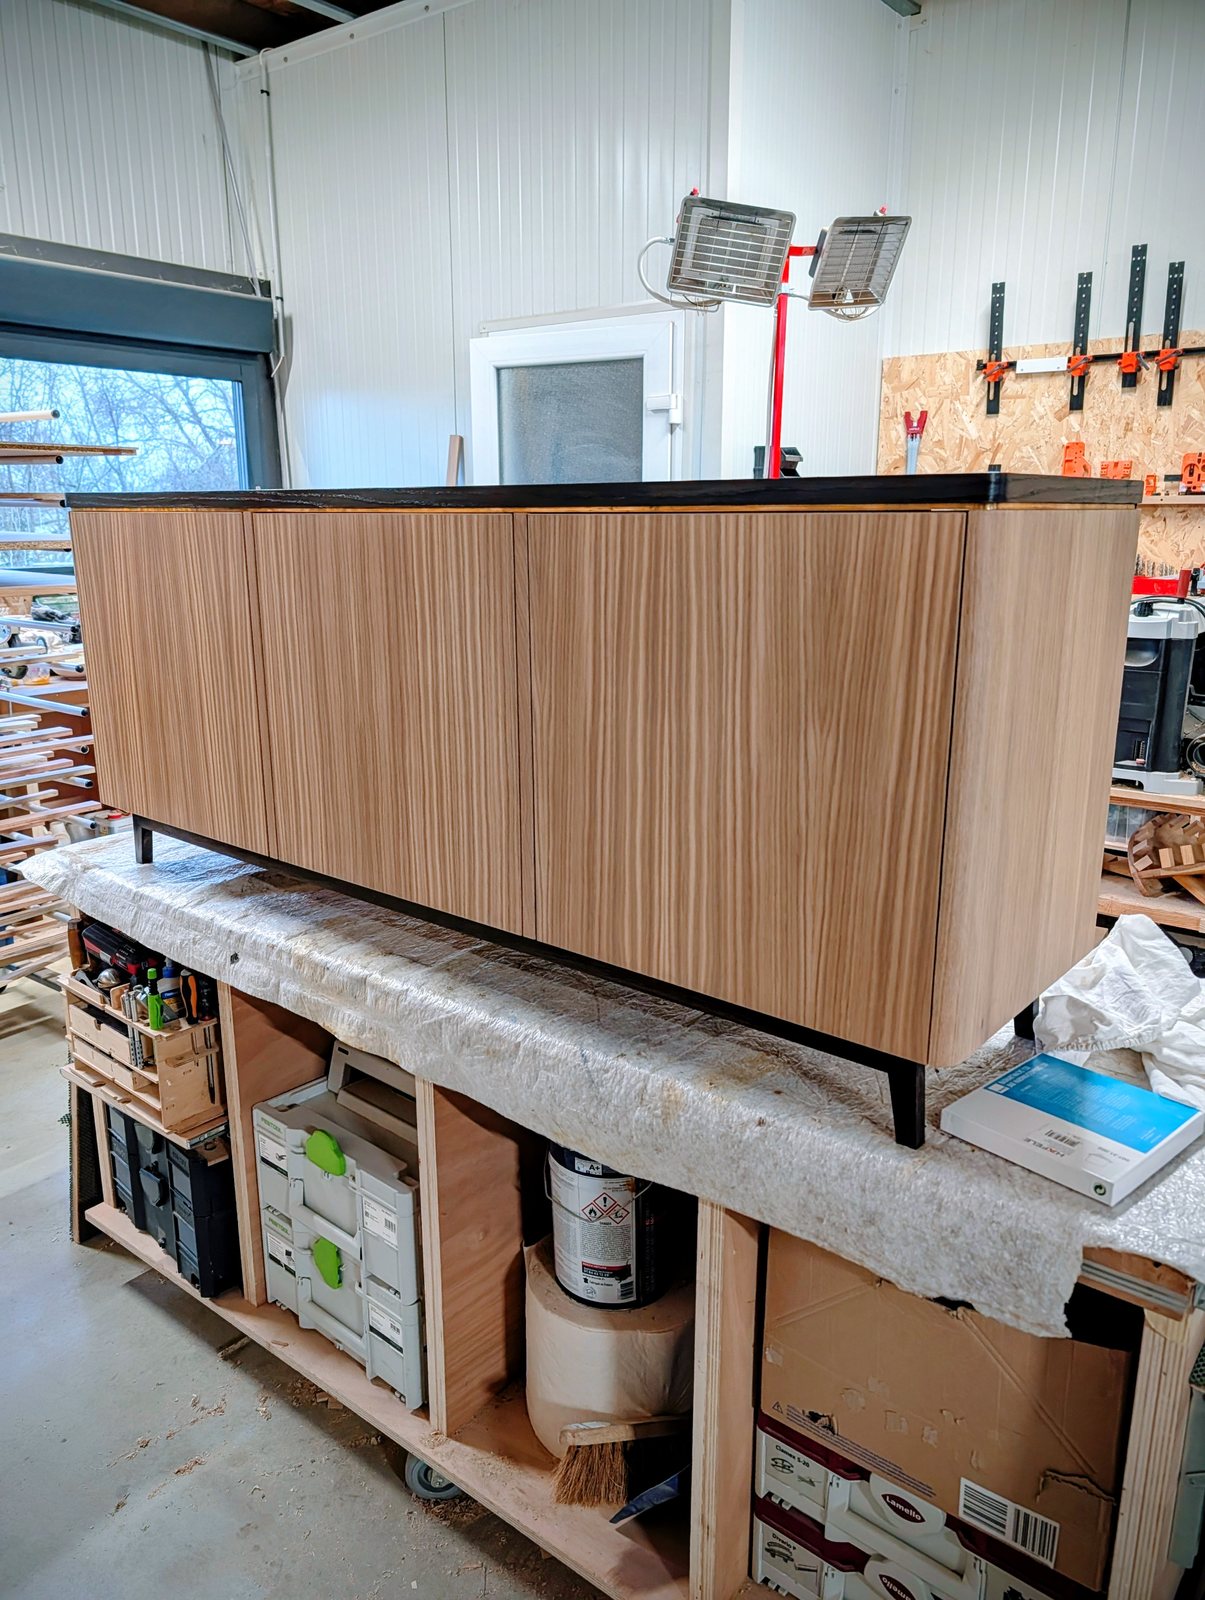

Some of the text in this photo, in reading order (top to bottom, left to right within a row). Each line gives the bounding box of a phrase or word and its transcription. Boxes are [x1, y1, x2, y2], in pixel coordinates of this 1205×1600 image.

[260, 1116, 283, 1134] FESTOOL
[268, 1217, 290, 1236] FESTOOL
[886, 1495, 922, 1521] Lamello
[881, 1576, 912, 1600] amello
